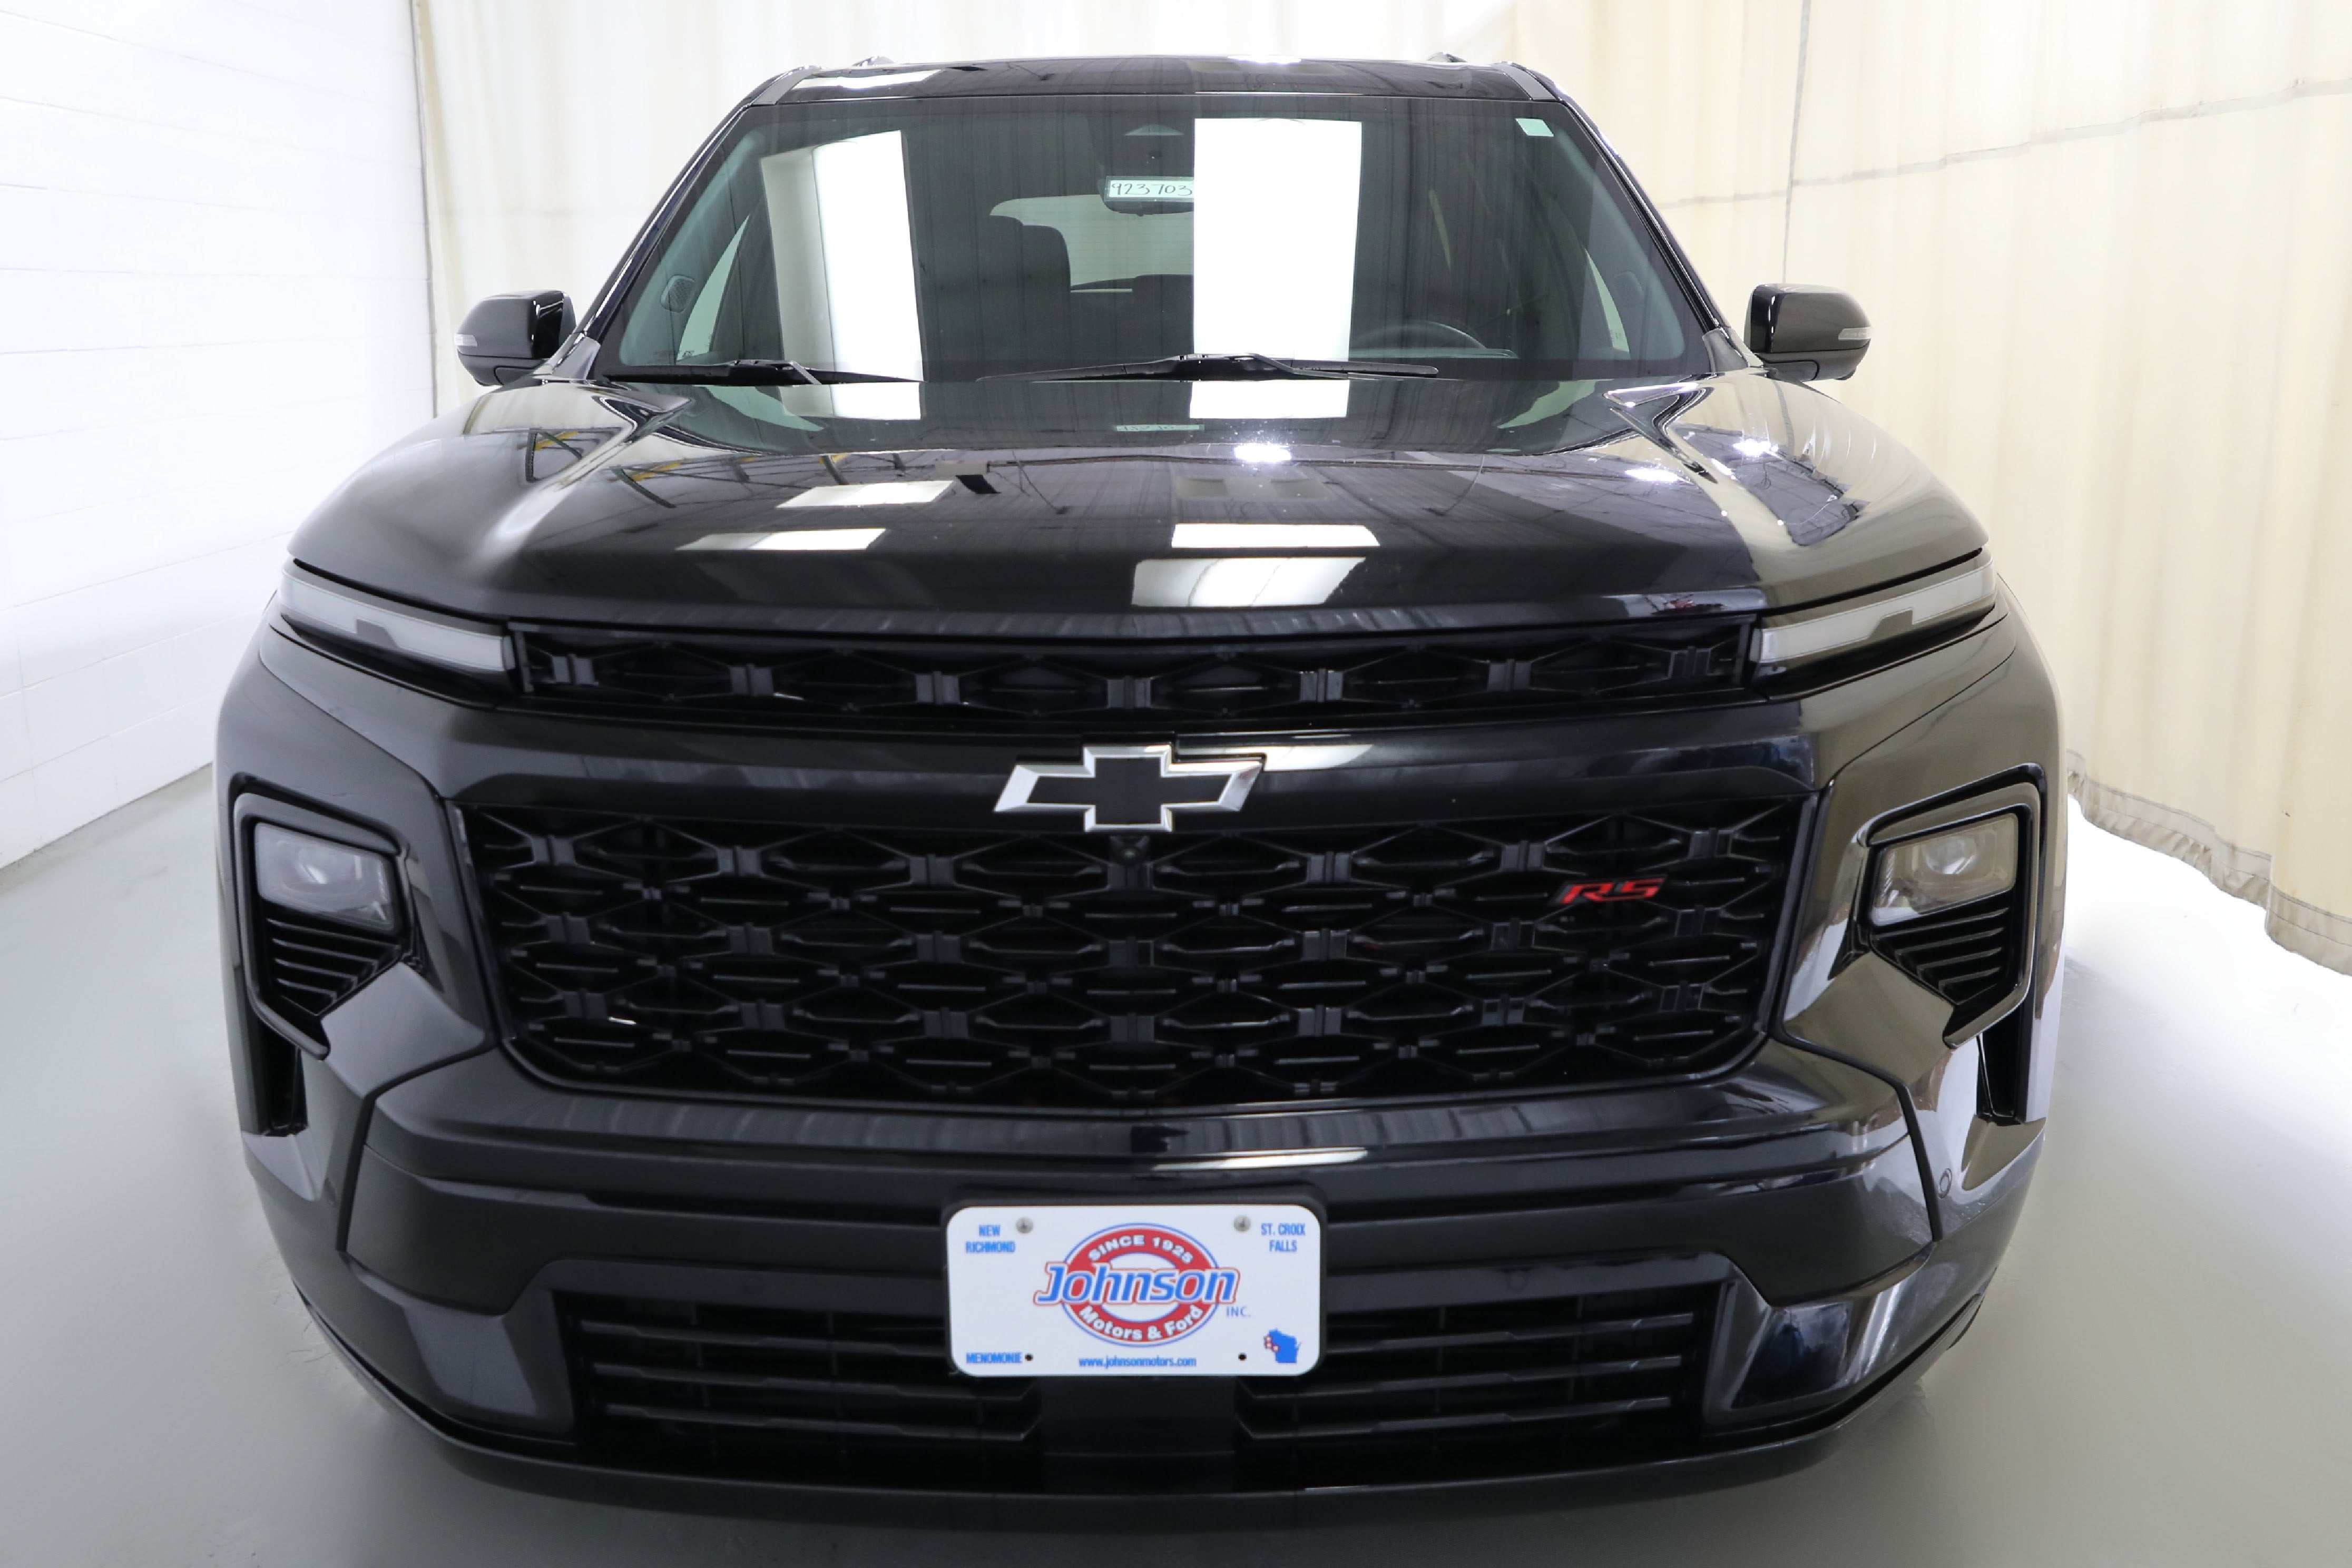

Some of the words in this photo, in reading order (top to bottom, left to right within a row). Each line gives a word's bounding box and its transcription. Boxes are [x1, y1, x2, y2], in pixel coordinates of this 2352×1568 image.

[1560, 877, 1665, 905] RS
[978, 1224, 1001, 1236] NEW
[1261, 1223, 1276, 1236] ST.
[1278, 1222, 1306, 1236] CROIX
[965, 1241, 1015, 1253] RICHMOND
[1088, 1234, 1145, 1261] SINCE
[1152, 1236, 1194, 1263] 1925
[1269, 1239, 1298, 1252] FALLS
[1036, 1265, 1237, 1302] Johnson
[1226, 1306, 1251, 1318] INC.
[1080, 1305, 1143, 1340] Motors
[1147, 1326, 1162, 1340] &
[1163, 1304, 1203, 1335] Ford
[966, 1352, 1023, 1364] MENOMONIE
[1079, 1355, 1197, 1369] www.johnsonmotors.com
